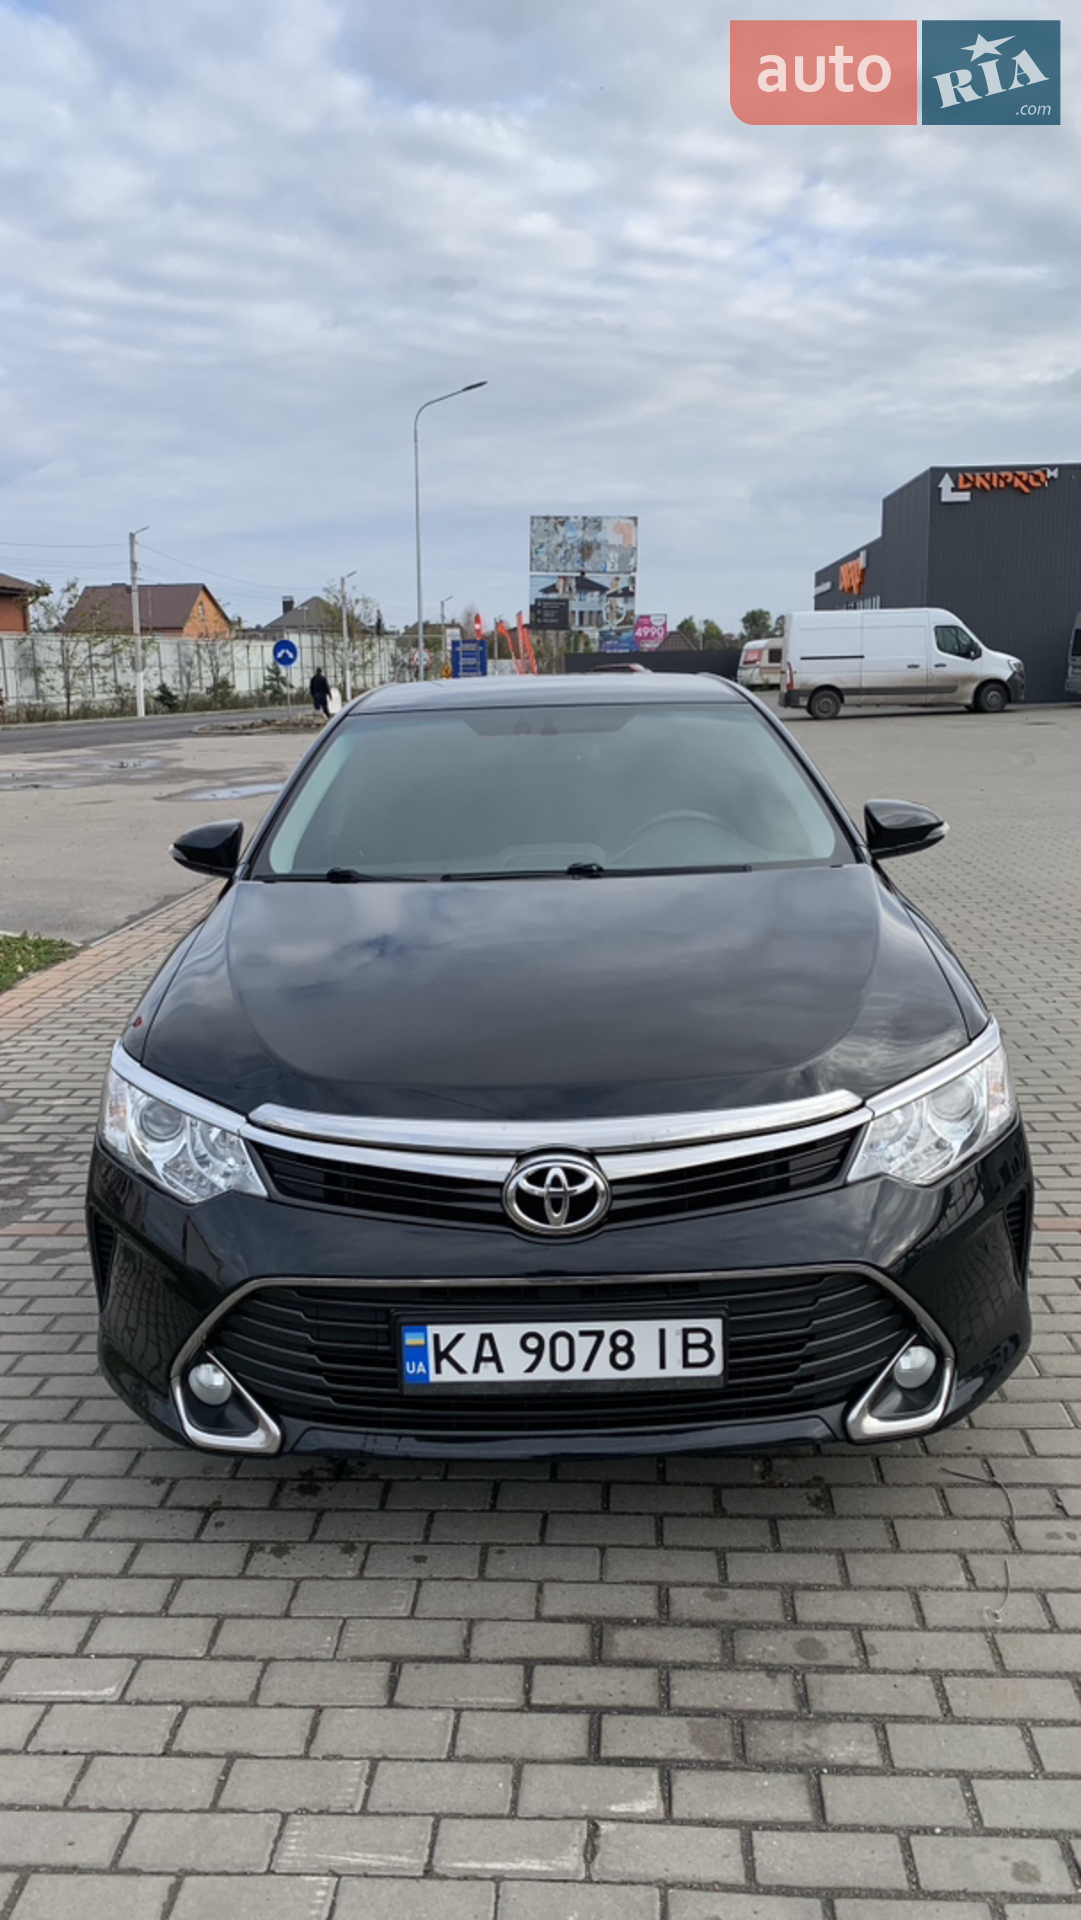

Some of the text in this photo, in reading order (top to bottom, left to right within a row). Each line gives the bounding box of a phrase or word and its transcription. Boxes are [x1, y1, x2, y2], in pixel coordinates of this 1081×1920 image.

[957, 468, 1049, 494] DNIPRO
[635, 626, 665, 637] 4990
[432, 1327, 716, 1375] KA 9078 IB
[406, 1361, 427, 1375] UA
